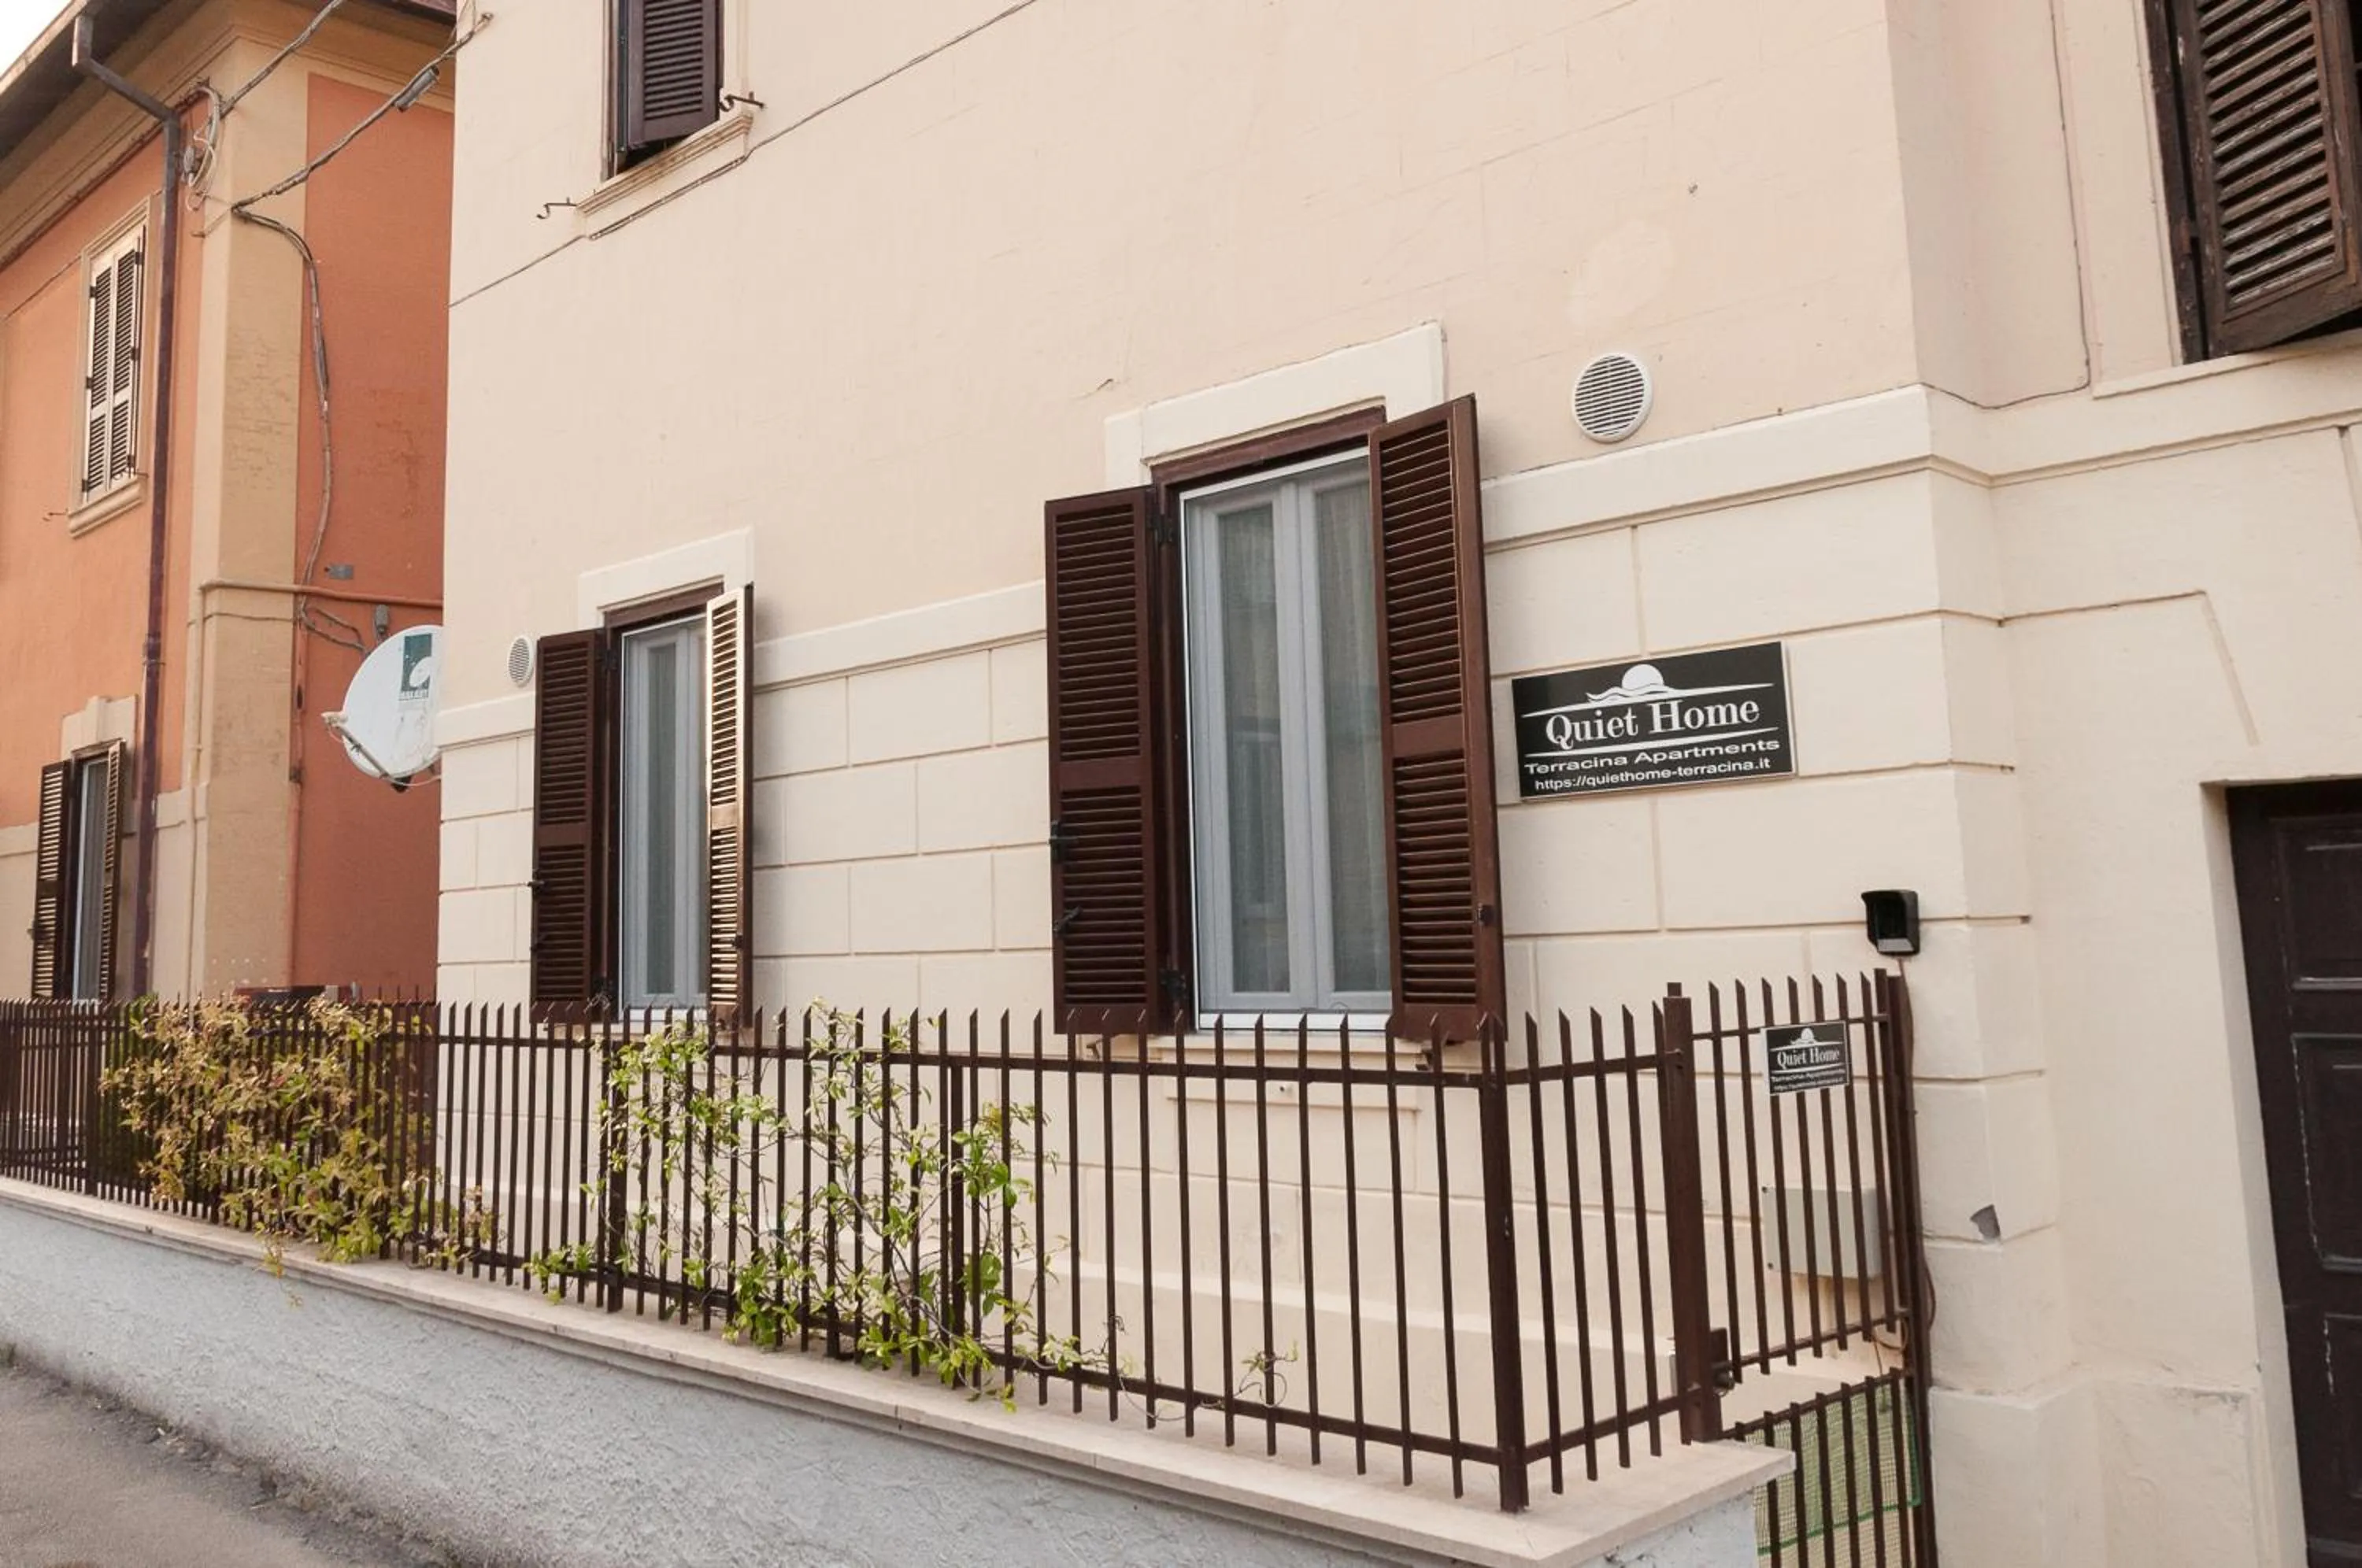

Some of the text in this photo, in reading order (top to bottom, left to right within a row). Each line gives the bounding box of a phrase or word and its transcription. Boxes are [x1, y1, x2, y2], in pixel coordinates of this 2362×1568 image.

[1546, 699, 1760, 749] Quiet Home
[1524, 739, 1780, 775] Terracina Apartments
[1535, 758, 1770, 791] https://quiethome-terracina.it
[1777, 1047, 1840, 1070] Quiet Home
